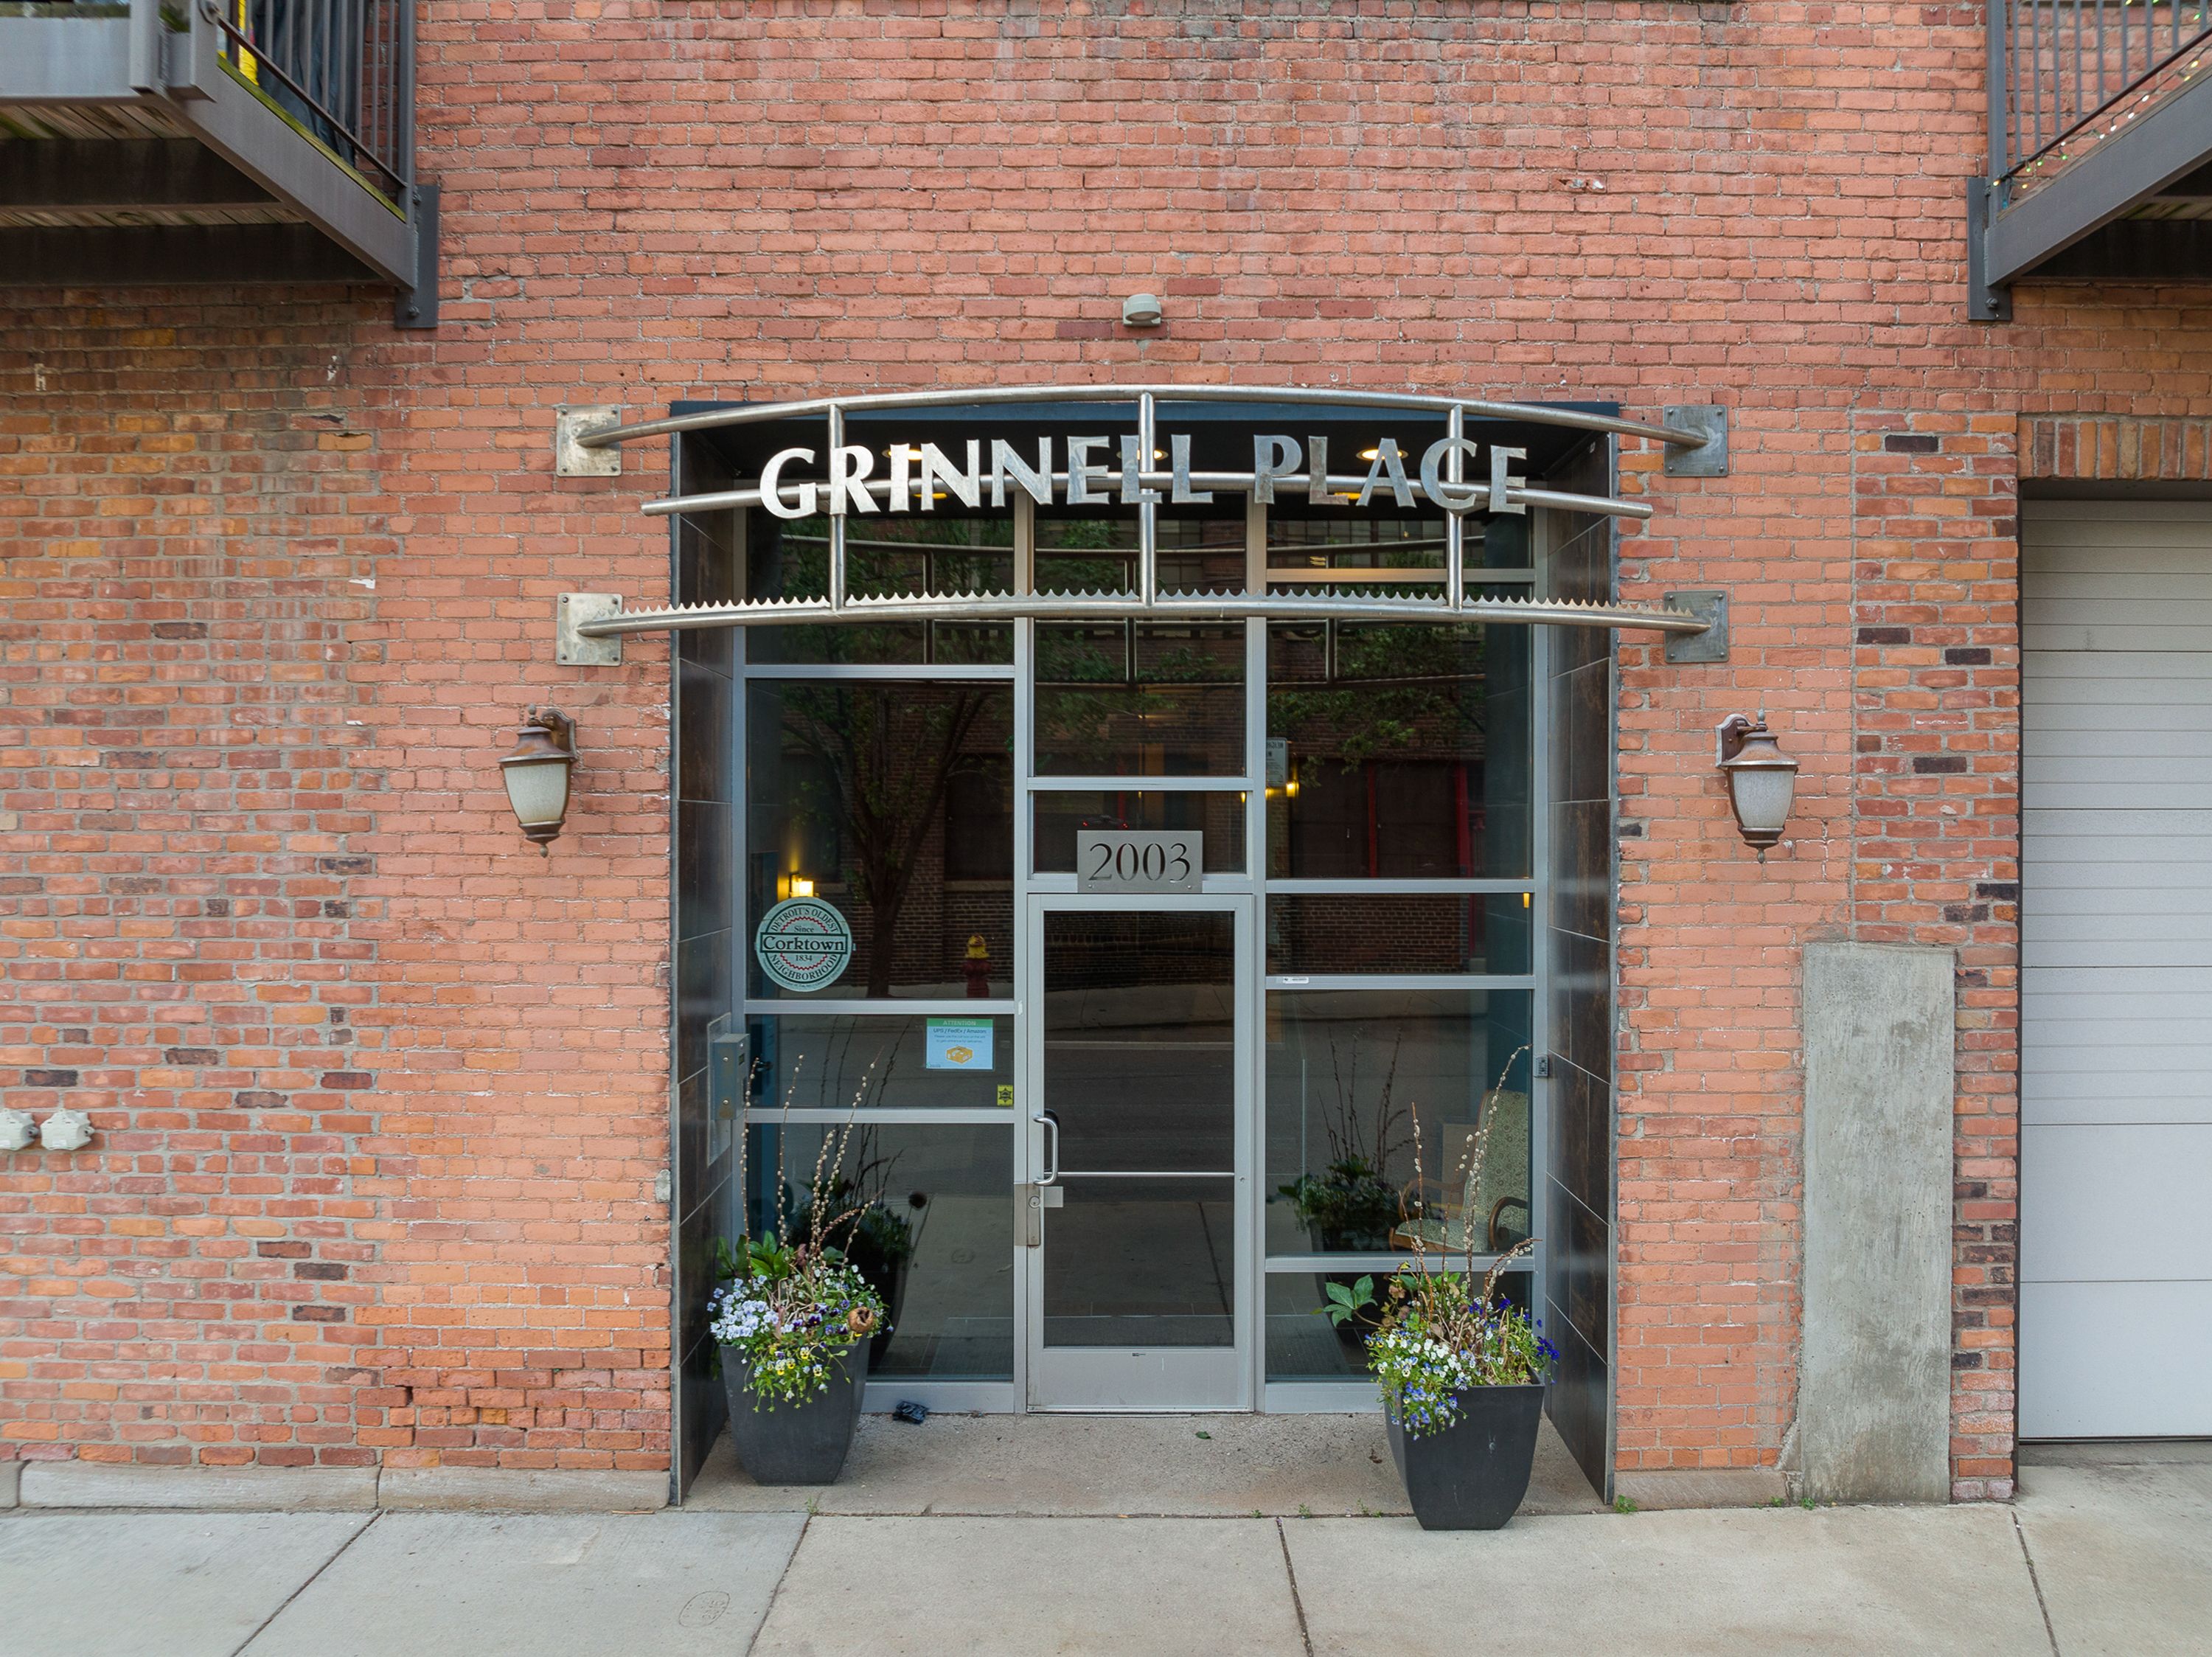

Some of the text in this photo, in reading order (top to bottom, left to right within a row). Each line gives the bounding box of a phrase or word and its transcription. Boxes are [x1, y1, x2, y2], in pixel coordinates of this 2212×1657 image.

[759, 434, 1527, 519] GRINNELL PLACE
[1088, 842, 1192, 882] 2003
[771, 906, 838, 933] DETROIT'S OLDEST
[793, 925, 814, 933] Since
[762, 935, 844, 951] Corktown
[770, 953, 838, 981] NEIGHBORHOOD
